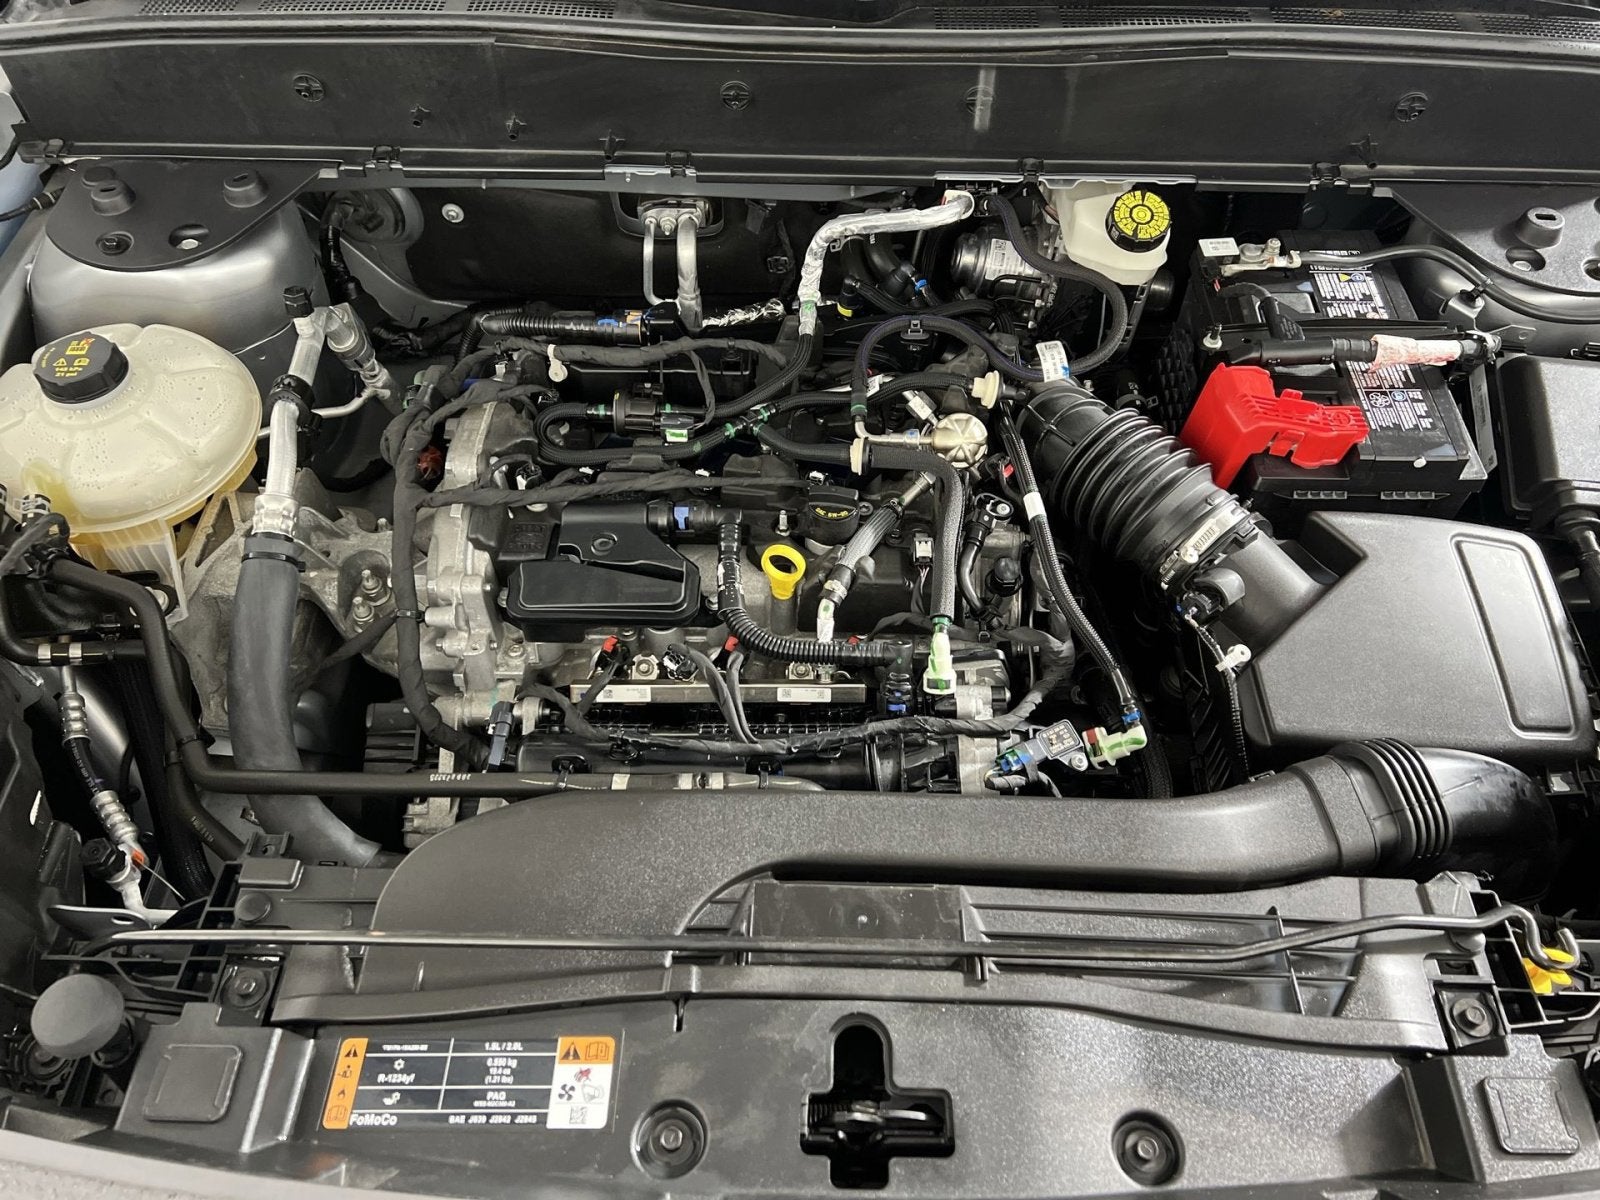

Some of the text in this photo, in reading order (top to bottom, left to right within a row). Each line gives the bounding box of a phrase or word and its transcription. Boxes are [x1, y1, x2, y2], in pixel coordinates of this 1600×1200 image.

[507, 1057, 518, 1069] kg
[377, 1073, 416, 1085] R-1234yf
[486, 1091, 507, 1101] PAG
[349, 1113, 398, 1126] FoMoCo
